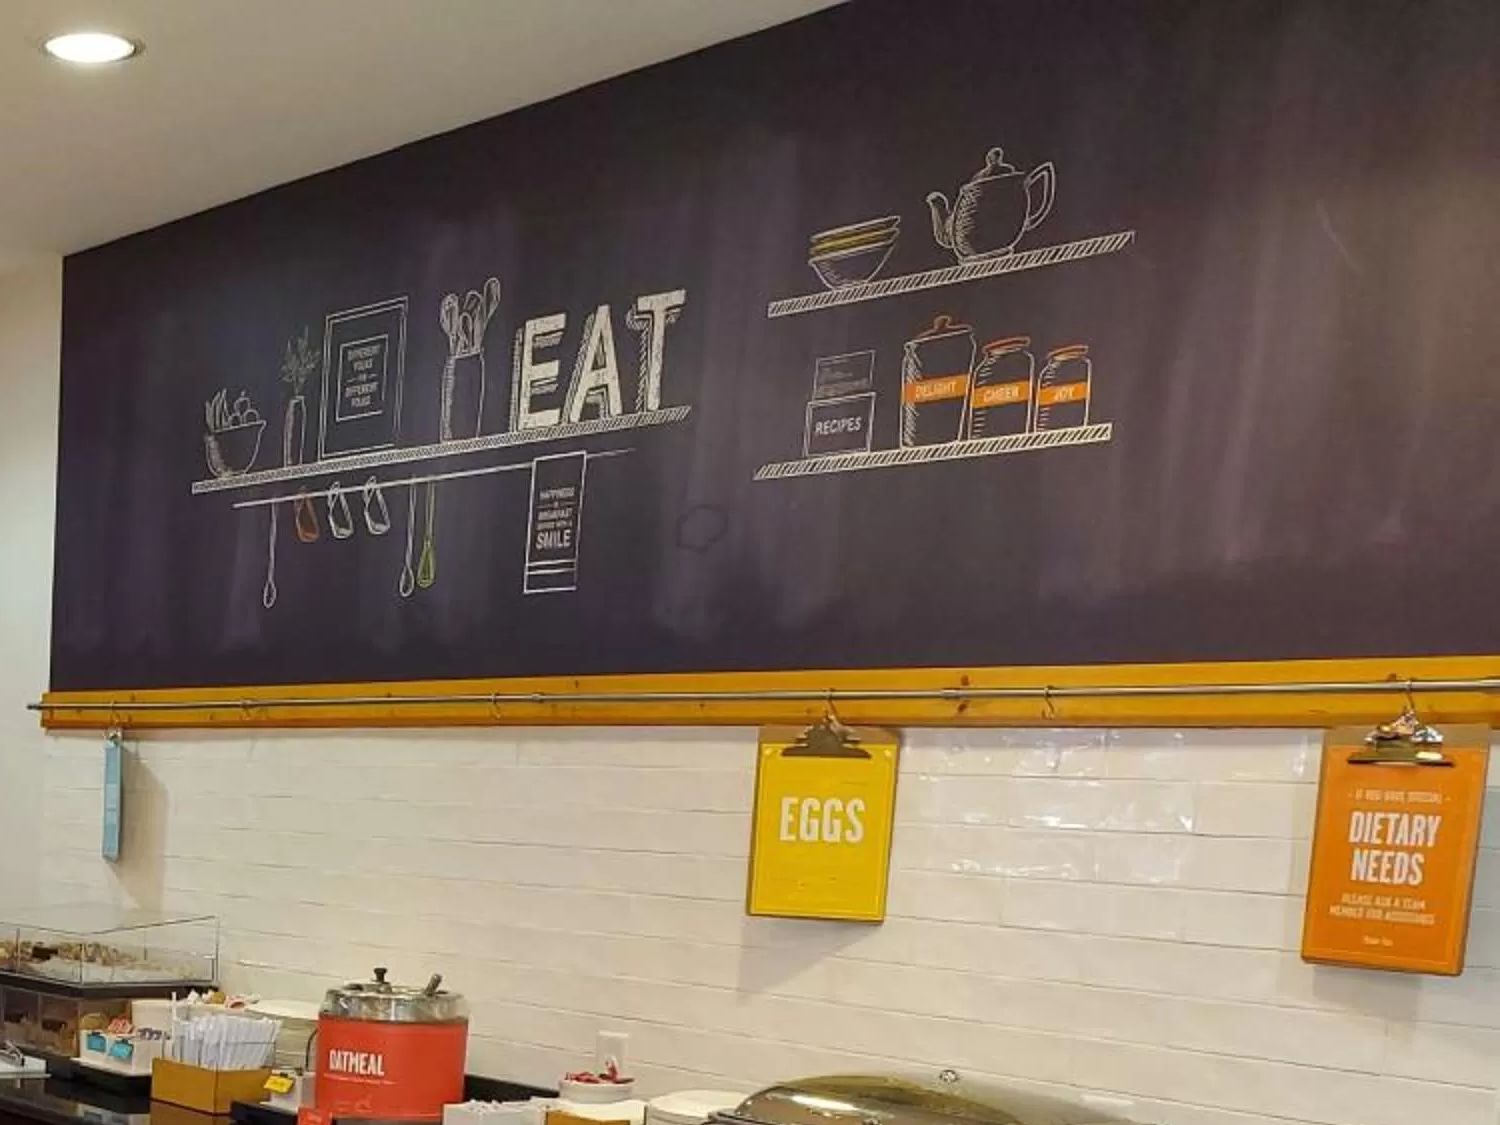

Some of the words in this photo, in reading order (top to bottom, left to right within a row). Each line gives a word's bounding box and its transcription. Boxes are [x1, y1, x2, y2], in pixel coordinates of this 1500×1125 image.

[512, 288, 686, 432] EAT
[916, 381, 957, 399] DELIGHT
[984, 386, 1019, 403] CHEER
[1053, 385, 1075, 401] JOY
[815, 416, 861, 435] RECIPES
[536, 529, 571, 550] SMILE
[780, 796, 865, 843] EGGS
[1348, 811, 1442, 847] DIETARY
[1351, 848, 1424, 885] NEEDS
[329, 1049, 385, 1076] OATMEAL
